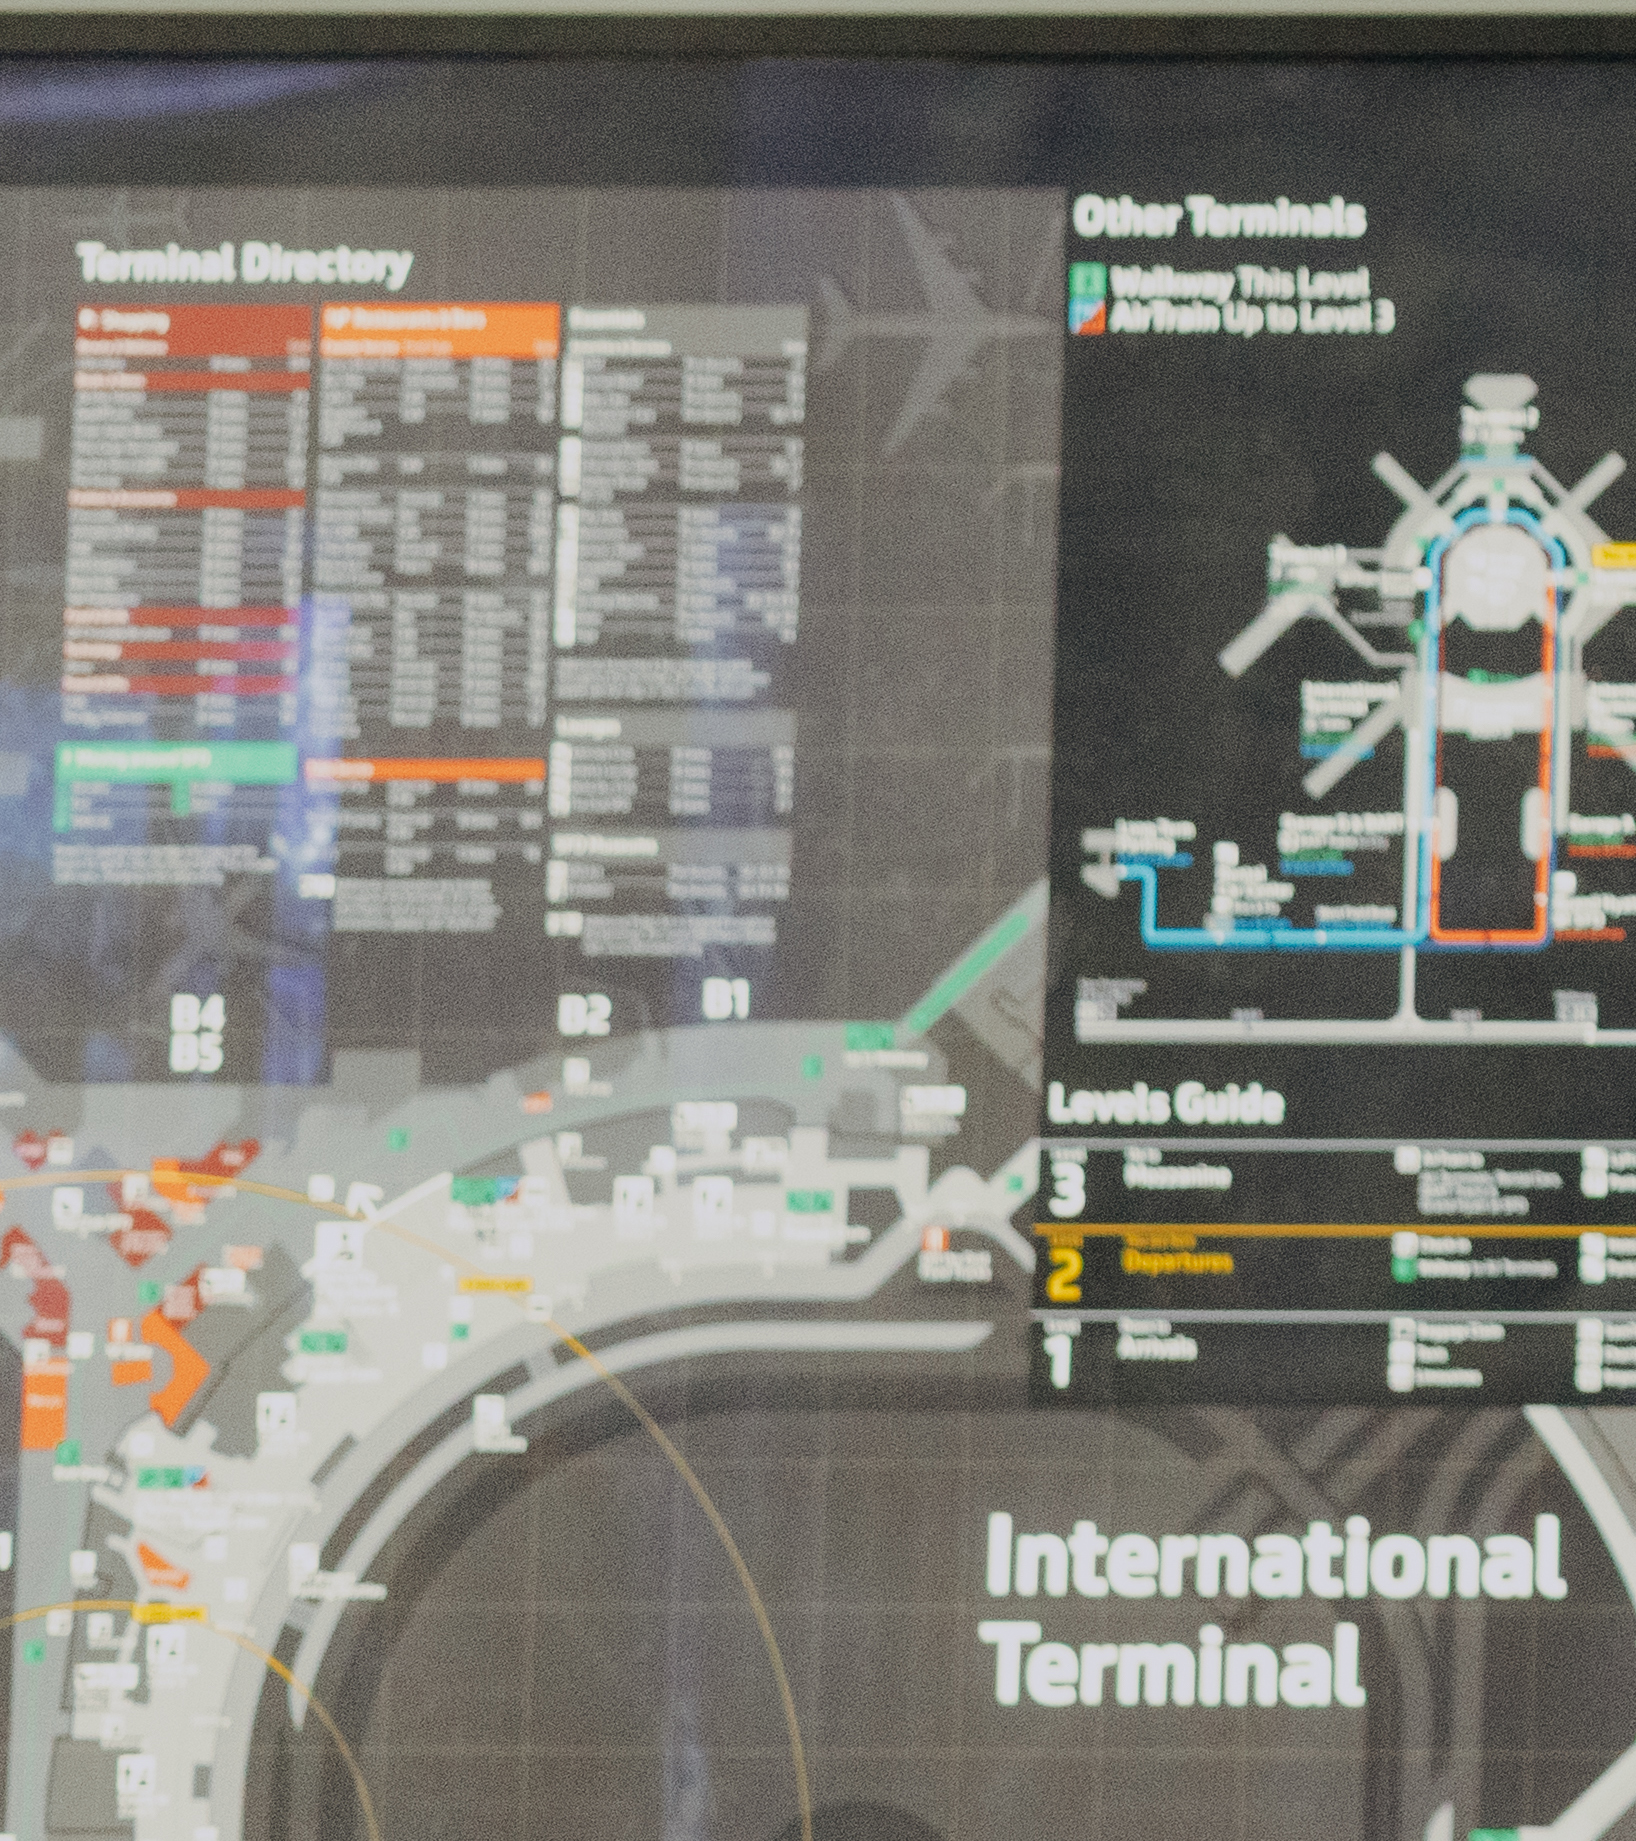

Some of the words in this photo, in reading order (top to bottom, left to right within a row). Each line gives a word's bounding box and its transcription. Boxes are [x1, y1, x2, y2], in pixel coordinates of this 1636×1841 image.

[1073, 194, 1184, 238] Other
[1185, 194, 1367, 238] Terminals
[76, 241, 237, 283] Terminal
[240, 241, 413, 291] Directory
[1109, 265, 1232, 304] Walkway
[1236, 264, 1294, 301] This
[1299, 267, 1370, 301] Level
[1110, 300, 1219, 333] AirTrain
[1223, 300, 1261, 337] Up
[1265, 302, 1296, 333] to
[1299, 300, 1369, 333] Level
[1373, 298, 1396, 334] 3
[170, 994, 226, 1032] B4
[557, 993, 612, 1036] B2
[701, 977, 750, 1018] B1
[169, 1033, 223, 1073] B5
[1047, 1082, 1172, 1124] Levels
[1173, 1081, 1285, 1125] Guide
[1049, 1161, 1086, 1217] 3
[1047, 1247, 1083, 1301] 2
[1043, 1334, 1073, 1388] 1
[985, 1511, 1567, 1600] International
[978, 1620, 1365, 1708] Terminal
